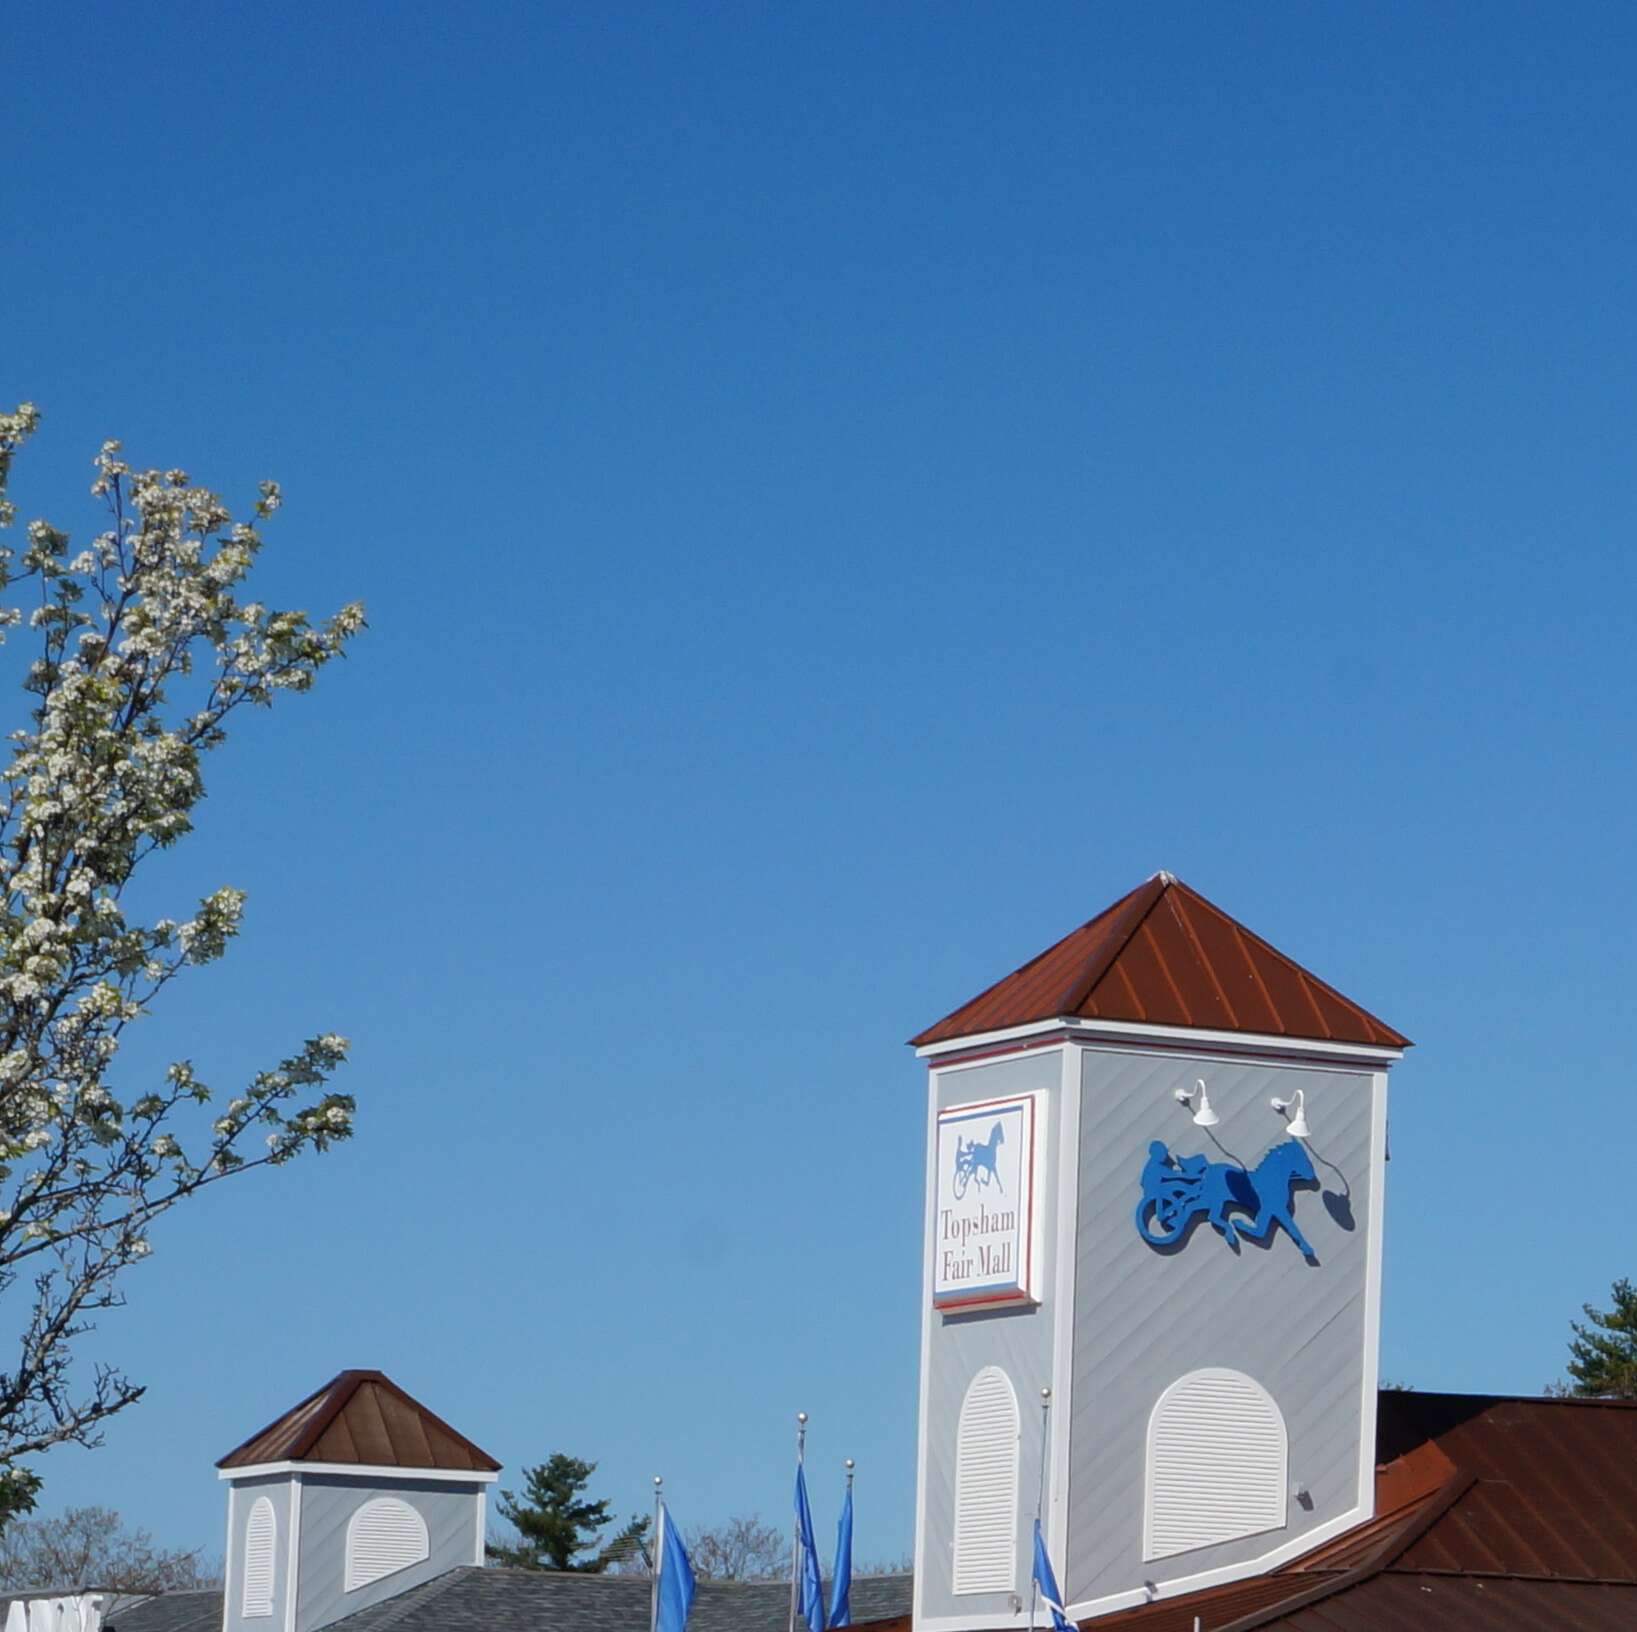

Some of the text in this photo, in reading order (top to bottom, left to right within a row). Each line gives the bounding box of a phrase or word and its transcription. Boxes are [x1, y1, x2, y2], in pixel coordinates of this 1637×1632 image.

[941, 1204, 1015, 1247] Topsham
[943, 1242, 1011, 1281] Fair Mall
